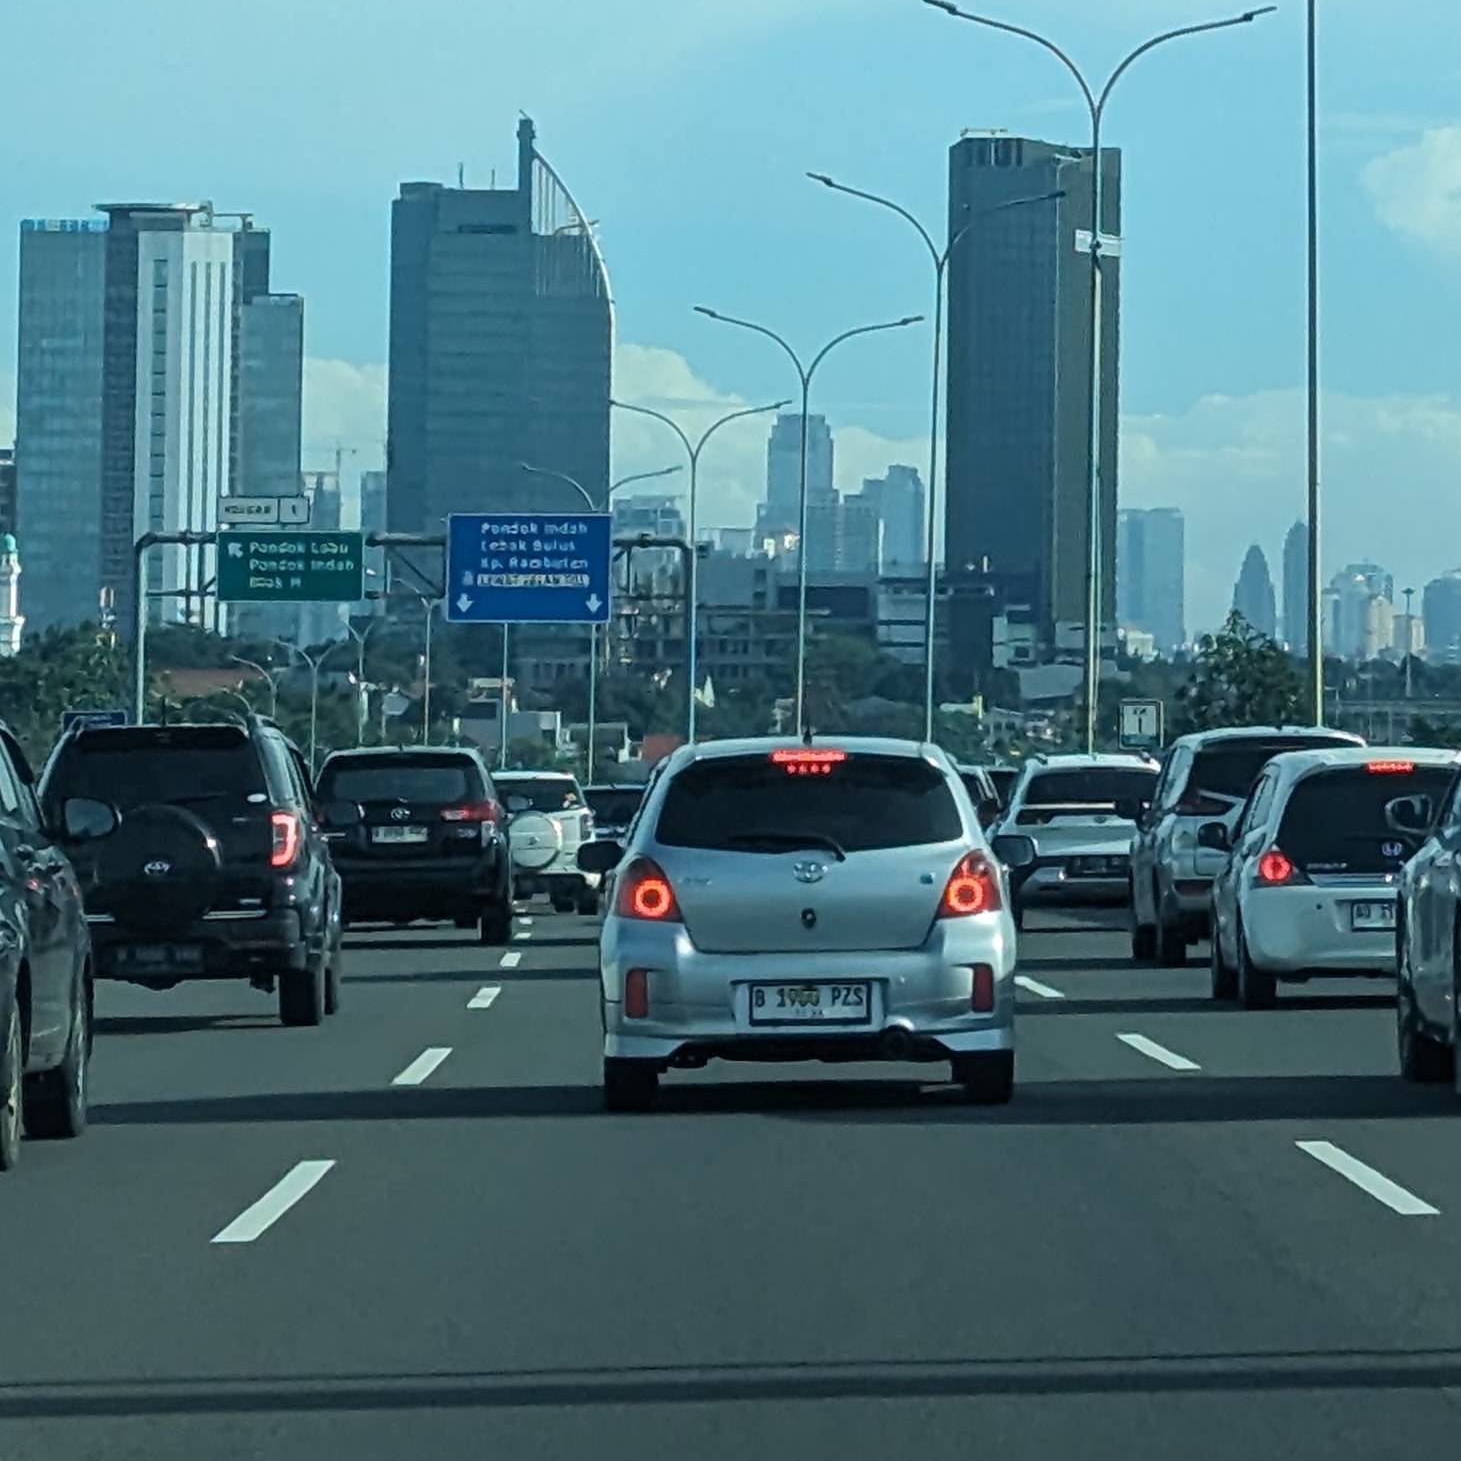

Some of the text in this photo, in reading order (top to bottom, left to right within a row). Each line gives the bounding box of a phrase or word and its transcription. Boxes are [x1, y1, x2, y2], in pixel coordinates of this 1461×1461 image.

[481, 522, 588, 535] Pondok Indah
[249, 542, 306, 554] Pondok
[249, 558, 305, 571] Pondok
[754, 988, 766, 1008] B
[831, 986, 864, 1008] PZS
